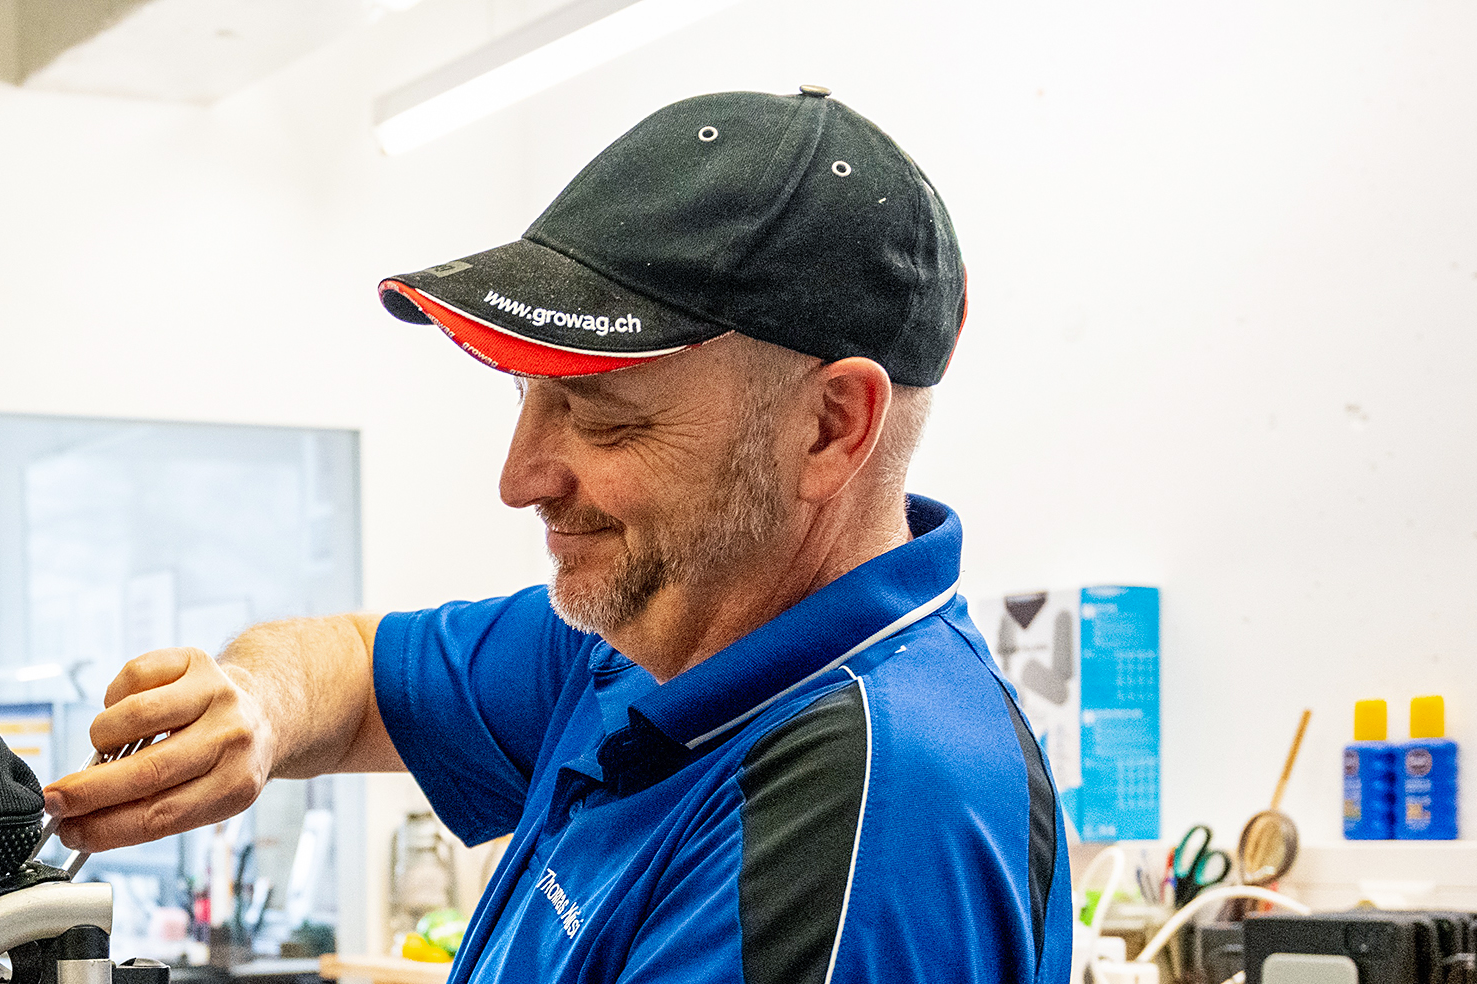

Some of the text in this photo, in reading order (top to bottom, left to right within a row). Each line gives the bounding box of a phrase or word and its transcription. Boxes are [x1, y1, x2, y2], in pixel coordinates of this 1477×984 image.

[484, 290, 641, 336] www.growag.ch
[462, 341, 499, 367] growag
[535, 867, 570, 915] Thomas
